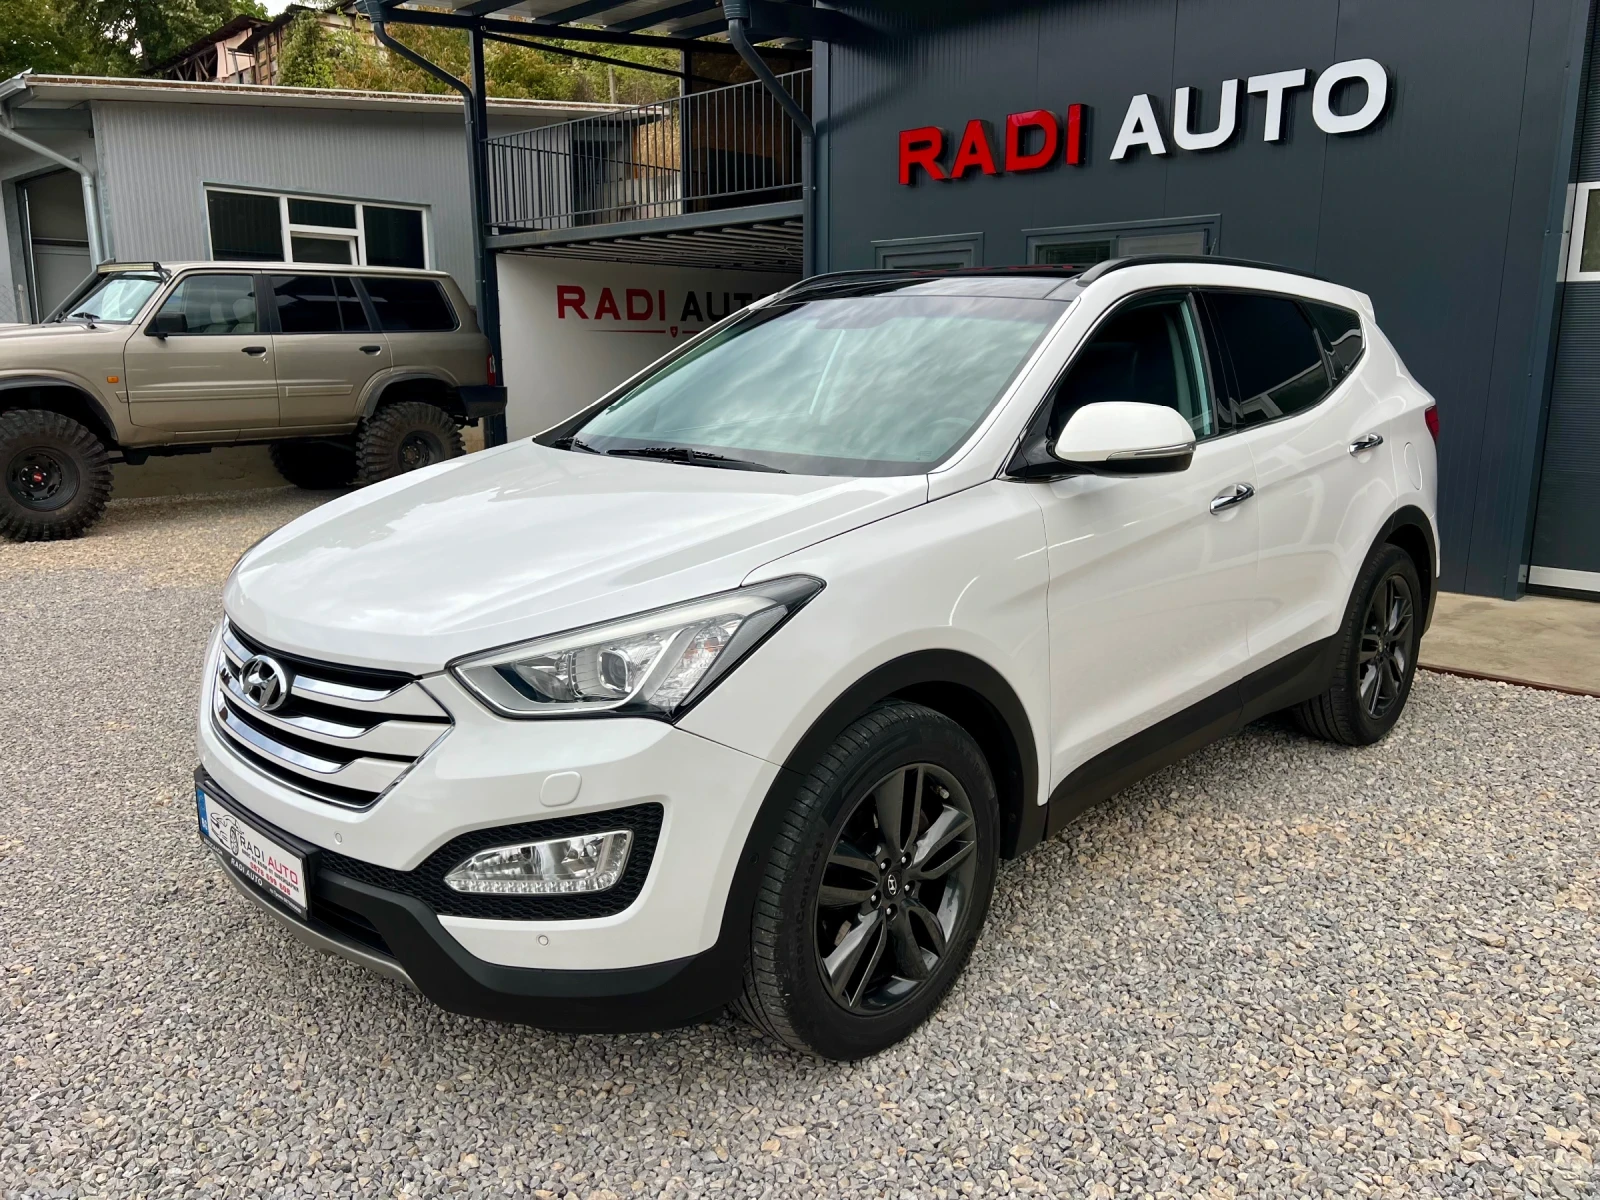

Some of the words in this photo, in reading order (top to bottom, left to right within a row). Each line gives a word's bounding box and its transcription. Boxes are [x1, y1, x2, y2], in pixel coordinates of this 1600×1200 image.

[899, 103, 1084, 186] RADI
[1110, 57, 1390, 161] AUTO
[556, 285, 666, 321] RADI
[680, 291, 776, 322] AUT
[230, 857, 245, 873] RADI
[246, 869, 263, 886] AUTO
[239, 835, 265, 862] RADI
[267, 856, 298, 885] AUTO
